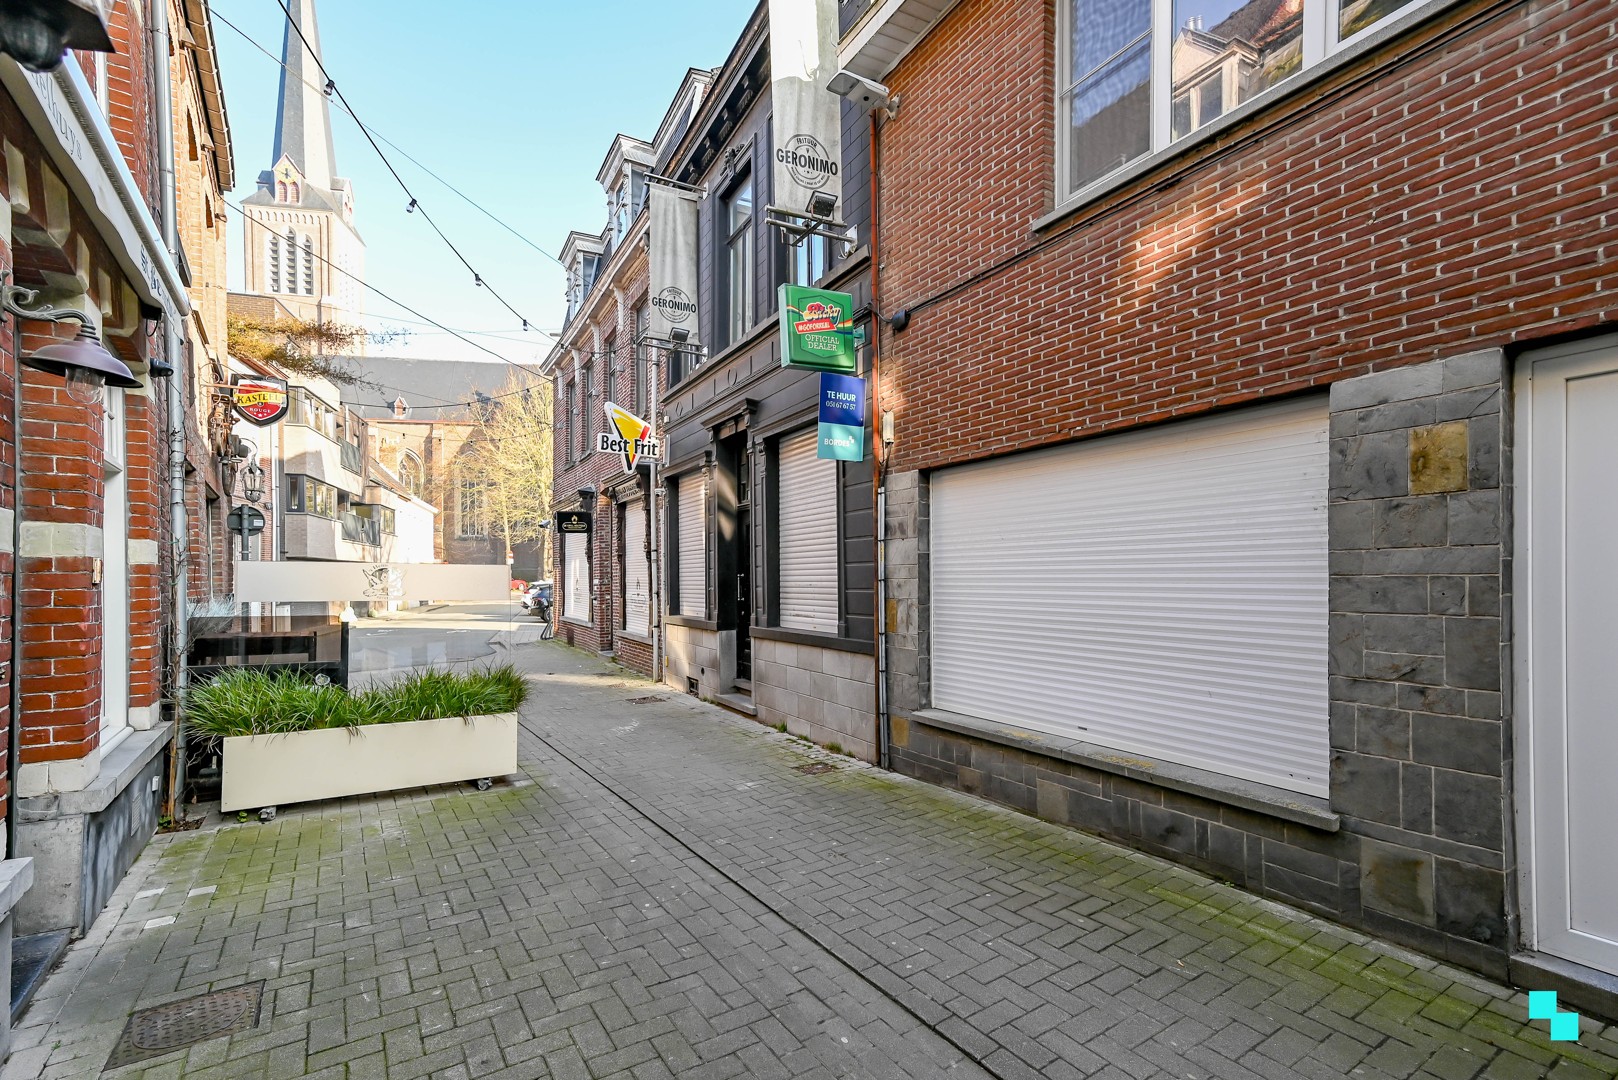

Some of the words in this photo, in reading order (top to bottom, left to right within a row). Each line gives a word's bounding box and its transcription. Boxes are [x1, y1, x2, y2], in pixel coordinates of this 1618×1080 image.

[796, 137, 818, 149] FRITUUR
[776, 148, 838, 176] GERONIMO
[651, 296, 697, 313] GERONIMO
[805, 333, 840, 345] OFFICIAL
[808, 341, 838, 352] DEALER
[237, 393, 279, 404] KASTEEL
[826, 390, 836, 399] TE
[836, 391, 856, 402] HUUR
[836, 401, 843, 409] 67
[843, 402, 850, 410] 67
[600, 434, 631, 453] Best
[634, 438, 658, 456] Frit
[824, 438, 850, 447] BORDES
